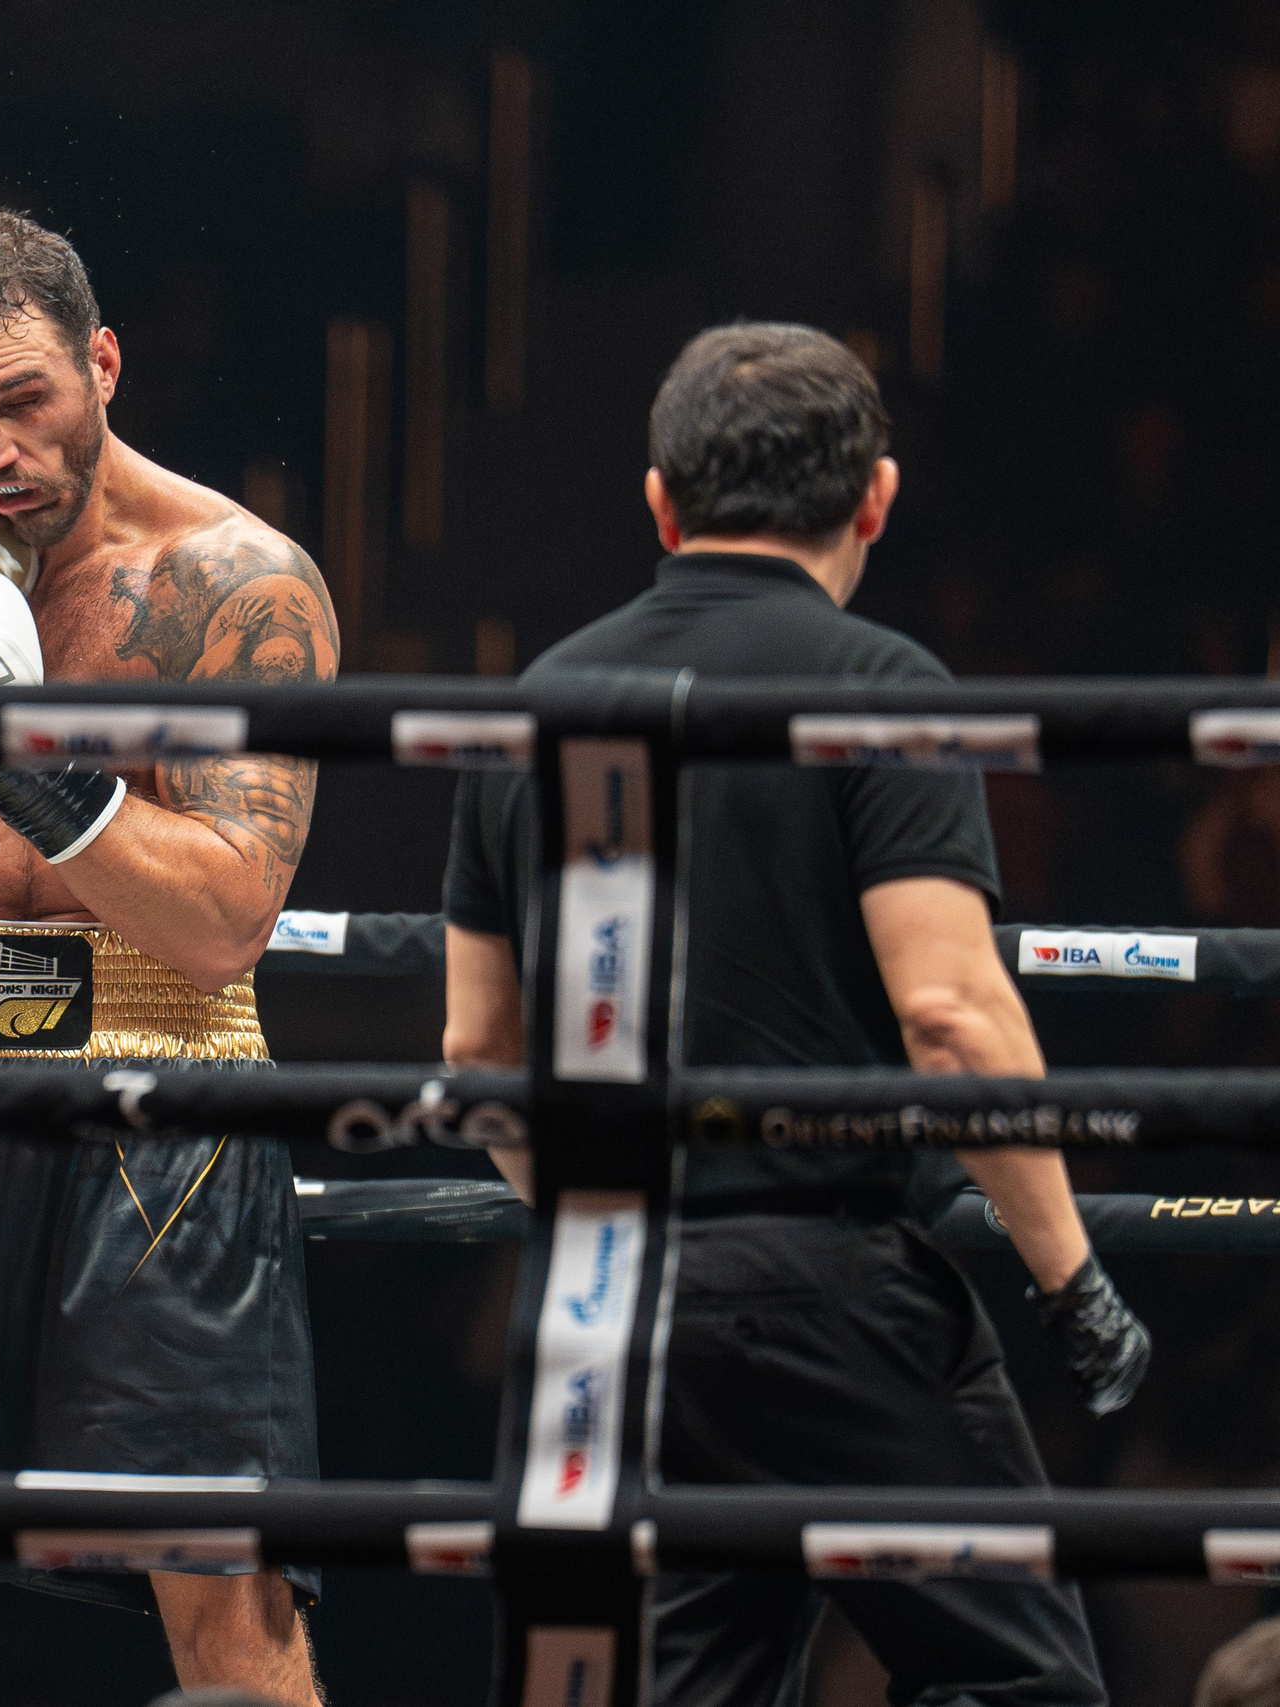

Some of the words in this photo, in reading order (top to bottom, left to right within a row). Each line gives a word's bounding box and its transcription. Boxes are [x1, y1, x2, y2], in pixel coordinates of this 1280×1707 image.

[1062, 947, 1101, 964] IBA
[1139, 954, 1180, 969] GAZPROM
[31, 985, 73, 995] NIGHT
